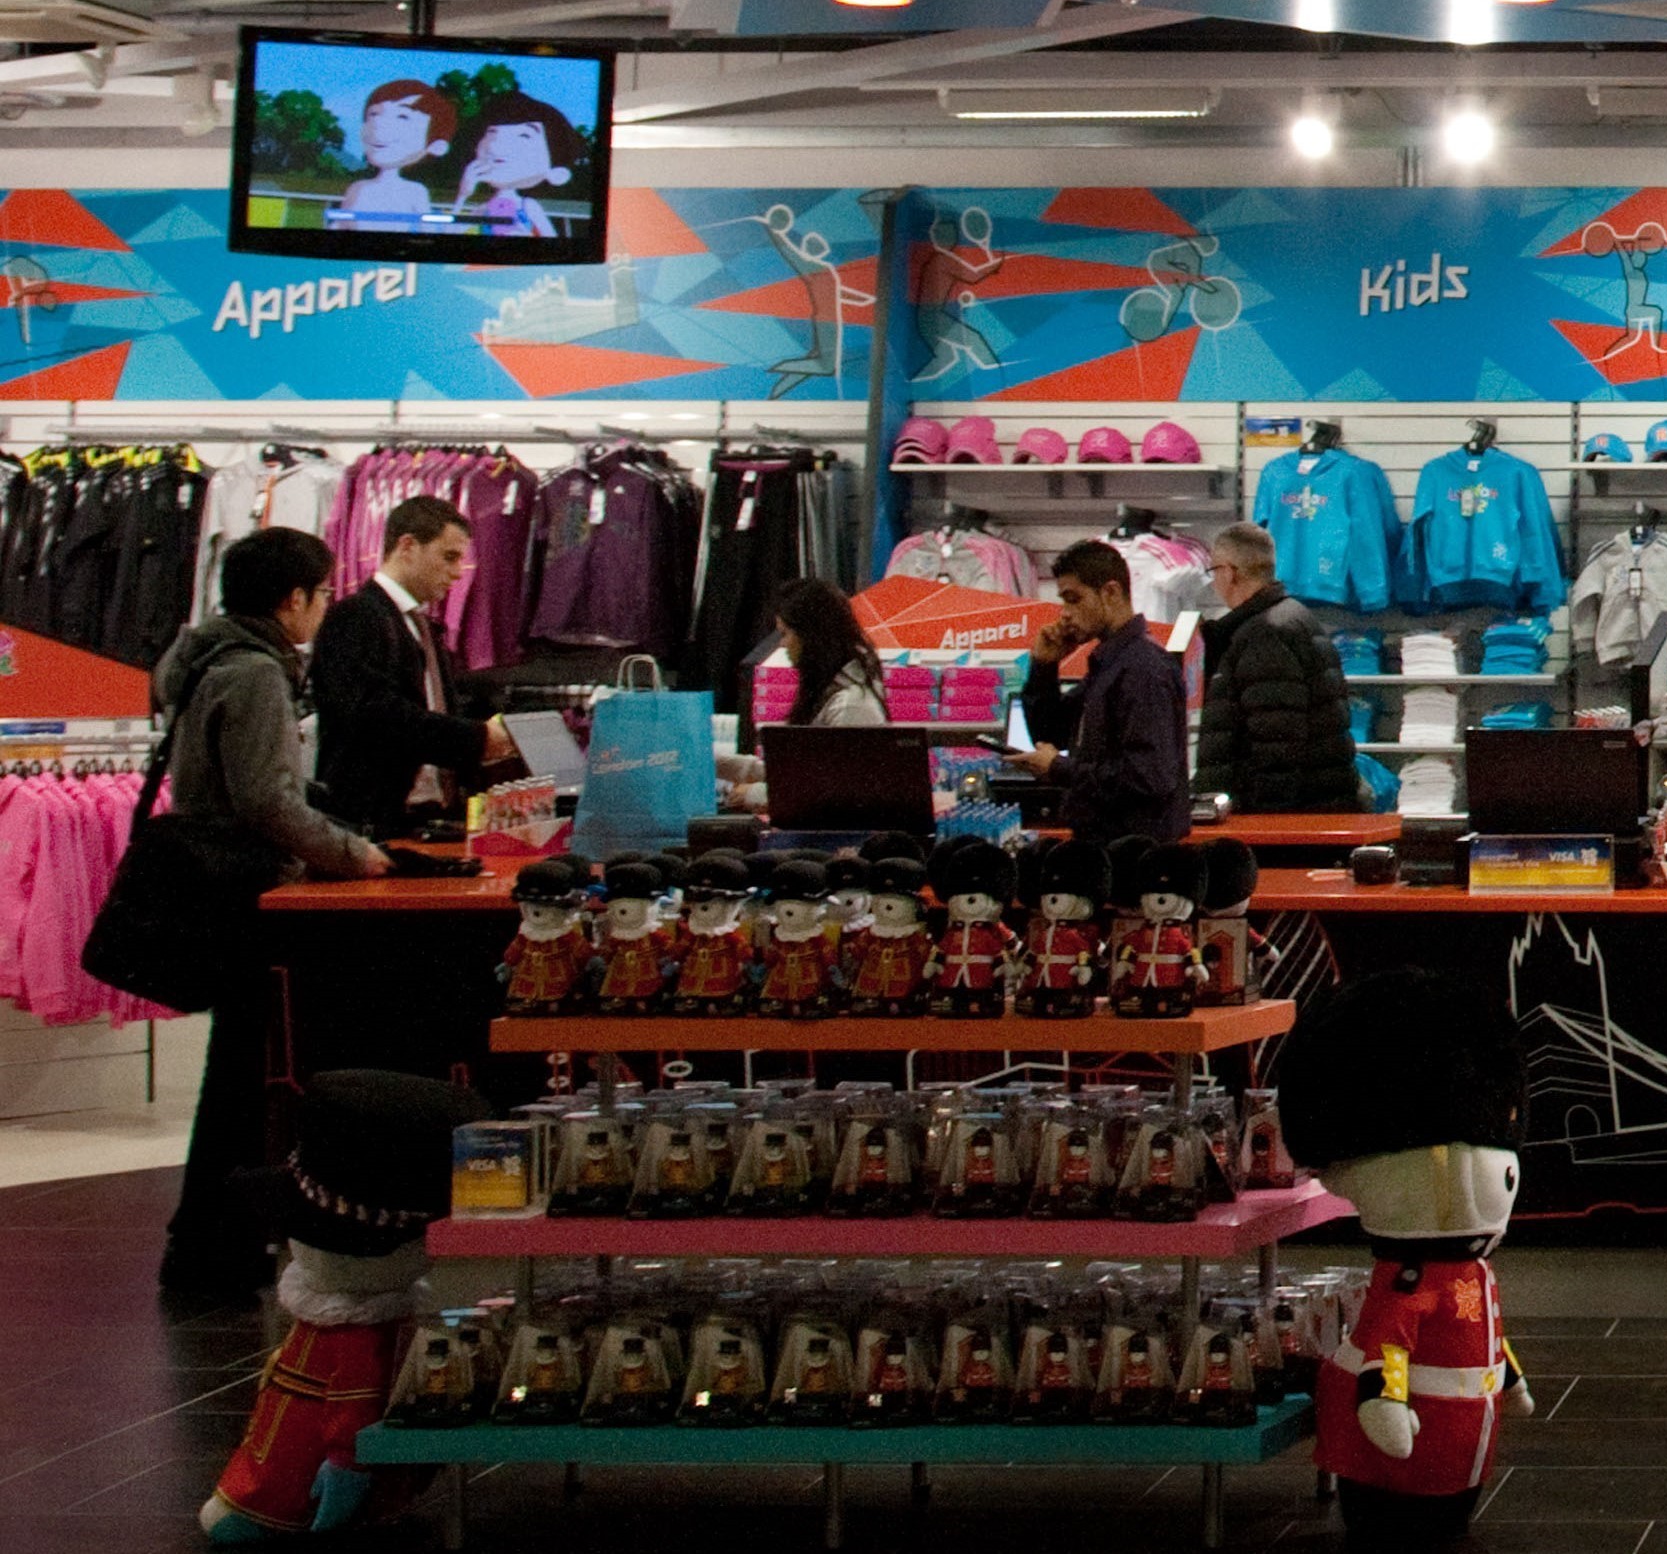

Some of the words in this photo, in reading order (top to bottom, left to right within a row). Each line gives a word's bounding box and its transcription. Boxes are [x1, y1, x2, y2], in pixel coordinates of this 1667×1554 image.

[211, 262, 417, 339] Apparel
[1358, 252, 1469, 317] Kids
[938, 614, 1029, 652] Apparel
